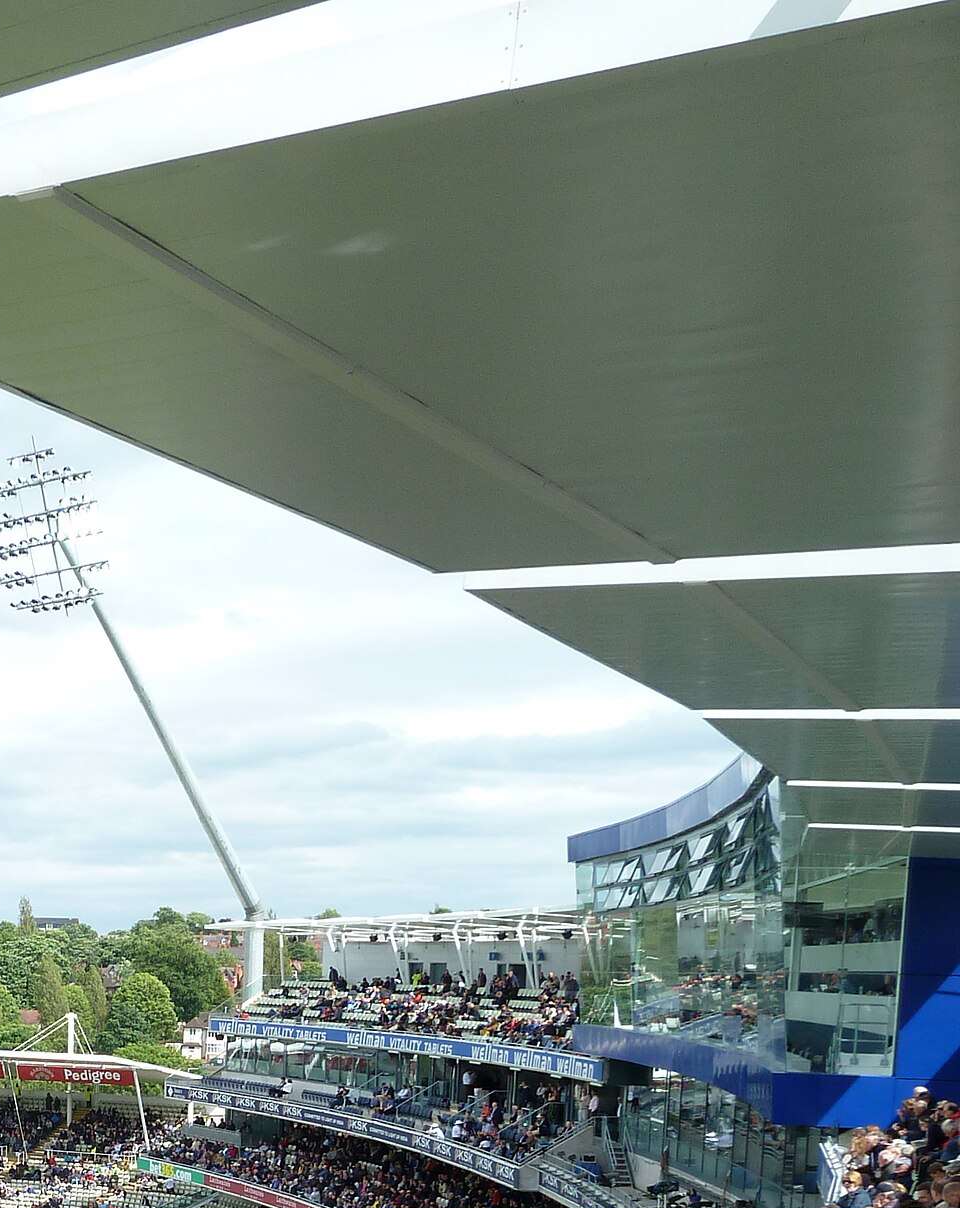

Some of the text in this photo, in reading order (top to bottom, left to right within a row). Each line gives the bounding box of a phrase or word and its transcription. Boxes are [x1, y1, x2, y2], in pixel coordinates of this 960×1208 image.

[218, 1021, 326, 1041] wellman VITALITY TABLETS
[346, 1031, 453, 1055] wellman VITALITY TABLETS
[471, 1044, 509, 1062] wellman
[513, 1049, 552, 1070] wellman
[556, 1056, 594, 1078] wellman
[64, 1069, 121, 1084] Pedigree
[352, 1120, 368, 1131] KSK
[150, 1161, 192, 1182] bet365.com
